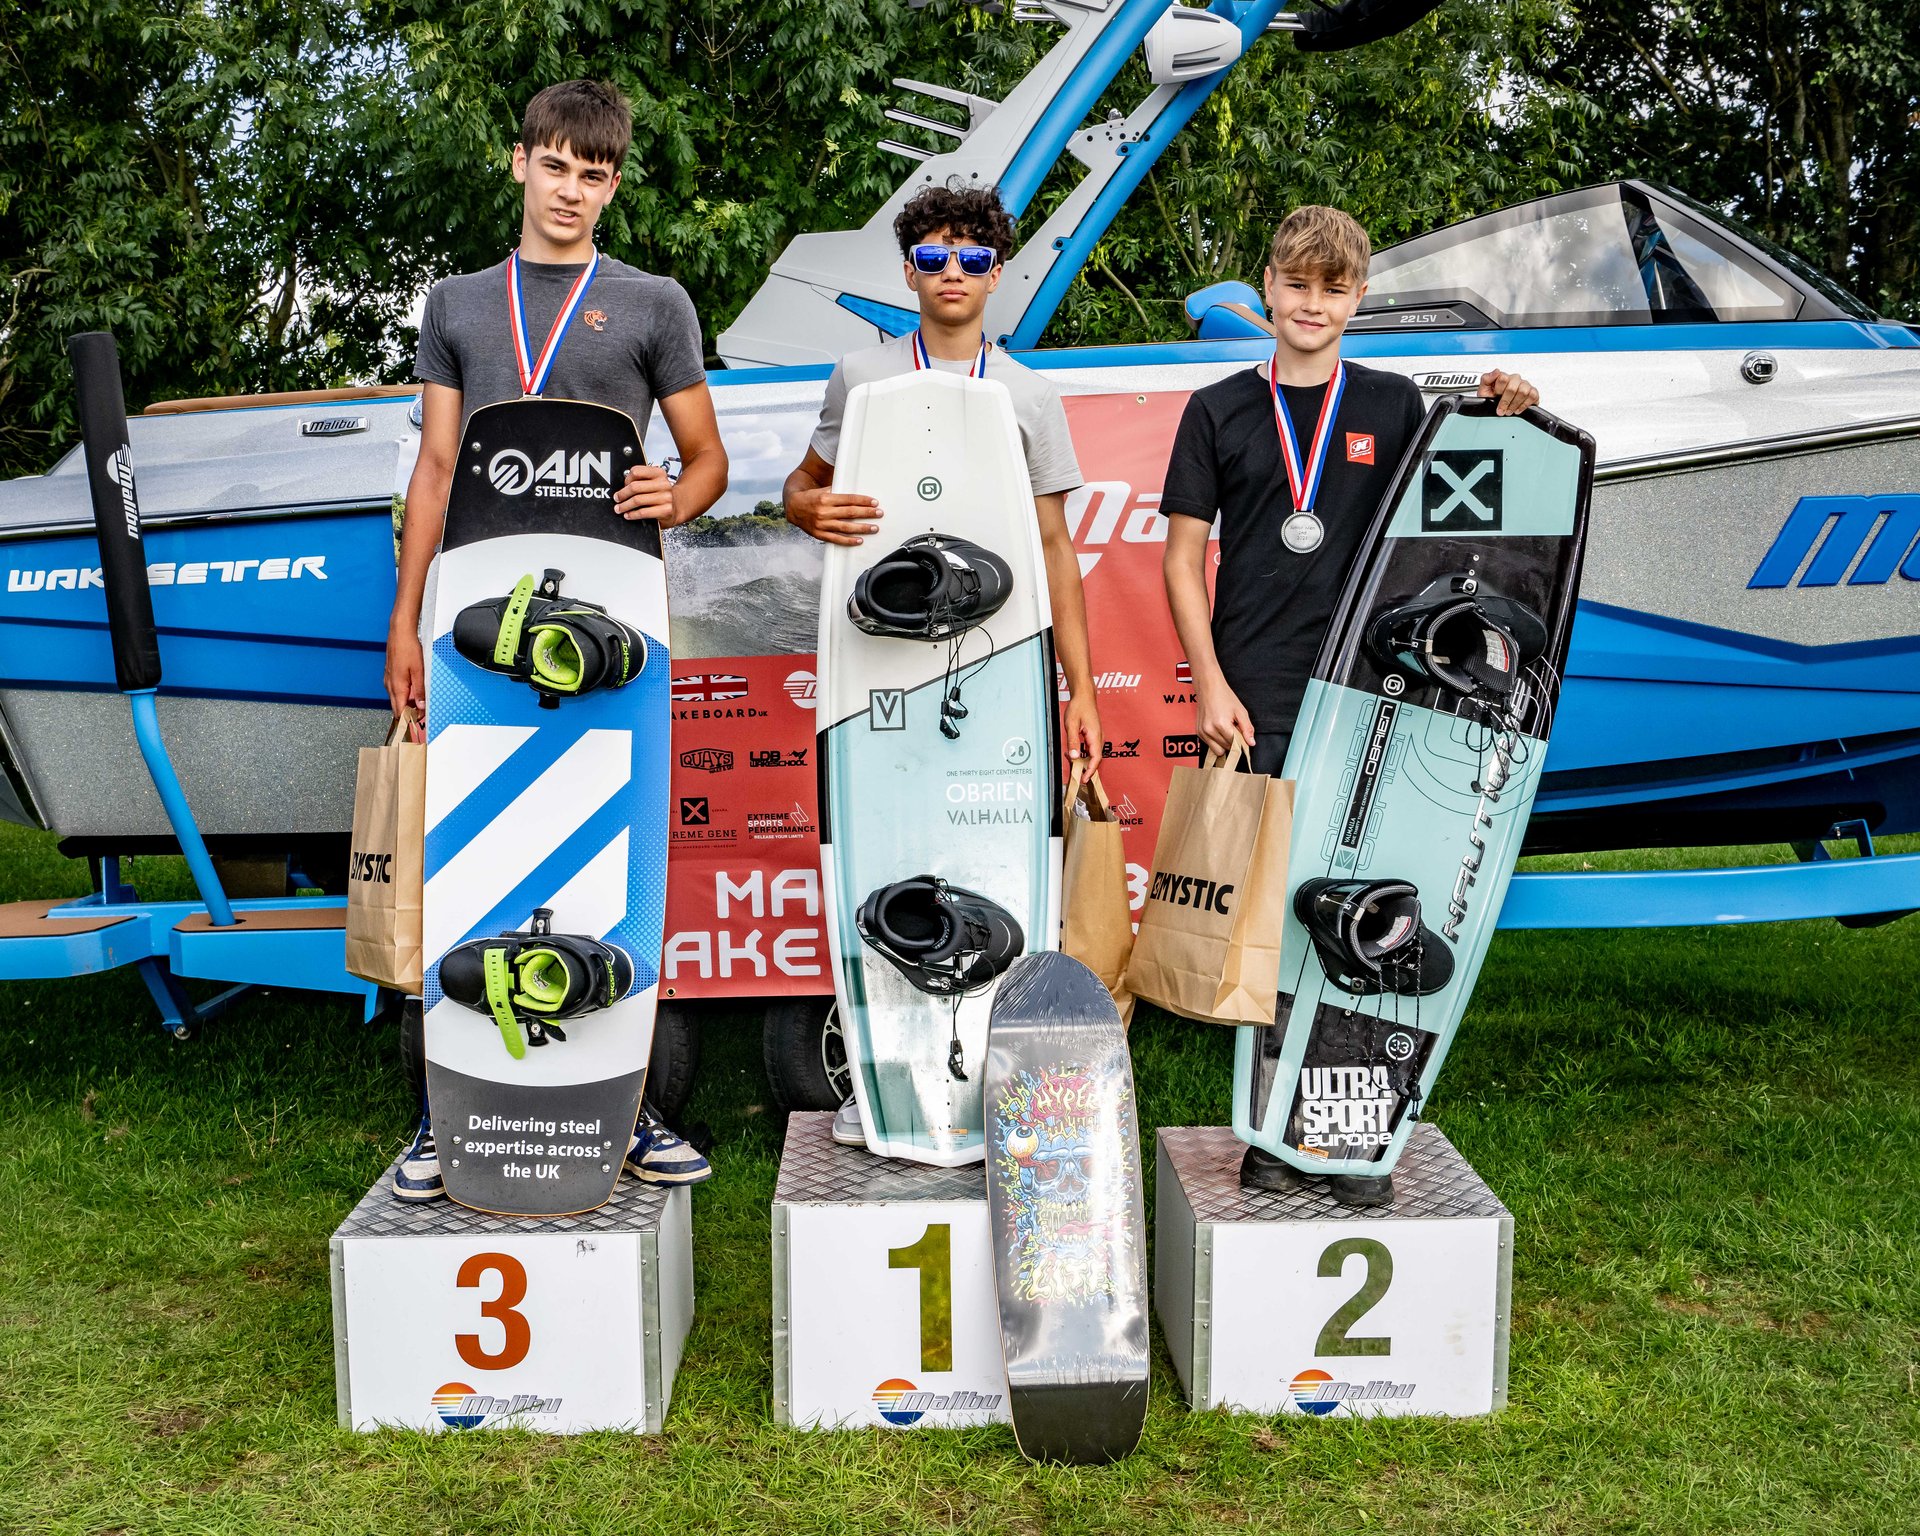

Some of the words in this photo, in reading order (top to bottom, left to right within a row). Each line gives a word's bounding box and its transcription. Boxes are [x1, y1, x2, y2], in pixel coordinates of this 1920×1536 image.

[1424, 374, 1478, 386] Malibu
[309, 419, 356, 432] Malibu
[535, 450, 611, 485] AJN
[117, 462, 139, 540] Malibu
[535, 485, 611, 499] STEELSTOCK
[1745, 493, 1920, 590] M
[7, 555, 328, 592] WAKSETTER
[671, 708, 757, 721] AKEBOARD
[1365, 704, 1394, 776] OBRIEN
[683, 750, 731, 768] QUAYS
[750, 750, 781, 761] LDB
[946, 781, 1033, 803] OBRIEN
[748, 812, 789, 820] EXTREME
[947, 808, 1033, 825] VALHALLA
[1442, 676, 1532, 944] NAUTIQUE
[707, 829, 737, 838] GENE
[748, 820, 783, 828] SPORTS
[748, 826, 816, 834] PERFORMANCE
[715, 868, 819, 919] MA
[1155, 872, 1235, 915] MYSTIC
[664, 928, 822, 980] AKE
[1301, 1066, 1393, 1100] ULTRA
[468, 1115, 556, 1136] Delivering
[560, 1119, 601, 1135] steel
[1302, 1098, 1393, 1134] SPORT
[464, 1140, 544, 1157] expertise
[547, 1144, 601, 1158] across
[1303, 1132, 1393, 1150] europe
[503, 1163, 531, 1178] the
[535, 1164, 560, 1179] UK
[888, 1223, 952, 1373] 1
[1314, 1237, 1393, 1357] 2
[455, 1252, 531, 1370] 3
[898, 1391, 1003, 1410] Malibu
[1314, 1381, 1416, 1401] Malibu
[458, 1395, 562, 1414] Malibu
